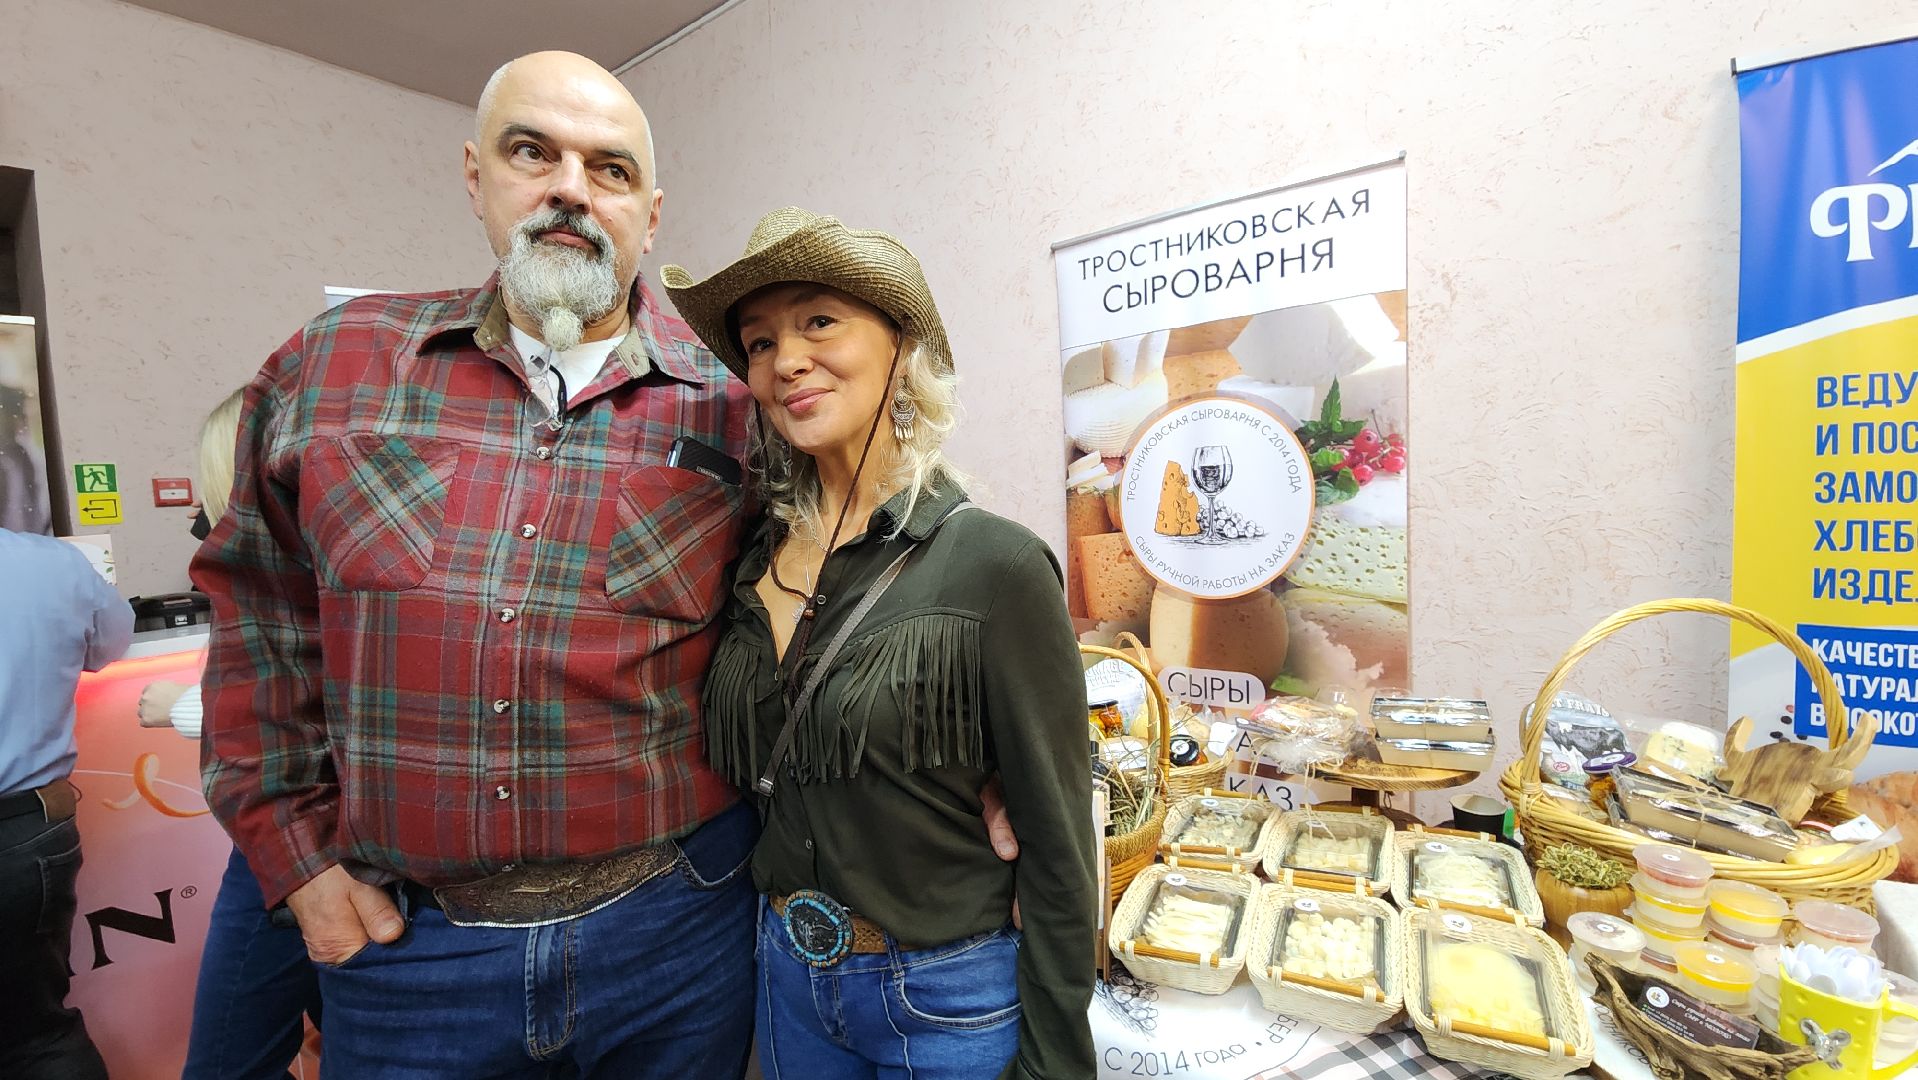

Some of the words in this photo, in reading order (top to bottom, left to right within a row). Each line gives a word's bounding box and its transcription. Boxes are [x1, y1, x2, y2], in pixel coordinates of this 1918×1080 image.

[1078, 188, 1371, 280] ТРОСТНИКОВСКАЯ
[1102, 237, 1334, 313] СЫРОВАРНЯ
[1816, 371, 1918, 409] ВЕДУ
[1127, 415, 1189, 502] ТРОСТНИКОВСКАЯ
[1191, 408, 1262, 429] СЫРОВАРНЯ
[1261, 425, 1272, 437] С
[1268, 432, 1288, 459] 2014
[1287, 457, 1302, 494] ГОДА
[1815, 423, 1839, 456] И
[1852, 420, 1918, 456] ПОС
[1814, 470, 1918, 505] ЗАМО
[1813, 519, 1918, 553] ХЛЕБ
[1135, 536, 1157, 564] СЫРЫ
[1156, 560, 1200, 588] РУЧНОЙ
[1202, 574, 1247, 590] РАБОТЫ
[1250, 565, 1267, 581] НА
[1265, 532, 1295, 568] ЗАКАЗ
[1812, 567, 1918, 605] ИЗДЕ
[1168, 671, 1250, 705] СЫРЫ
[1811, 672, 1918, 703] АТУРА
[68, 888, 176, 978] N
[1104, 1047, 1123, 1071] С
[1130, 1050, 1190, 1077] 2014
